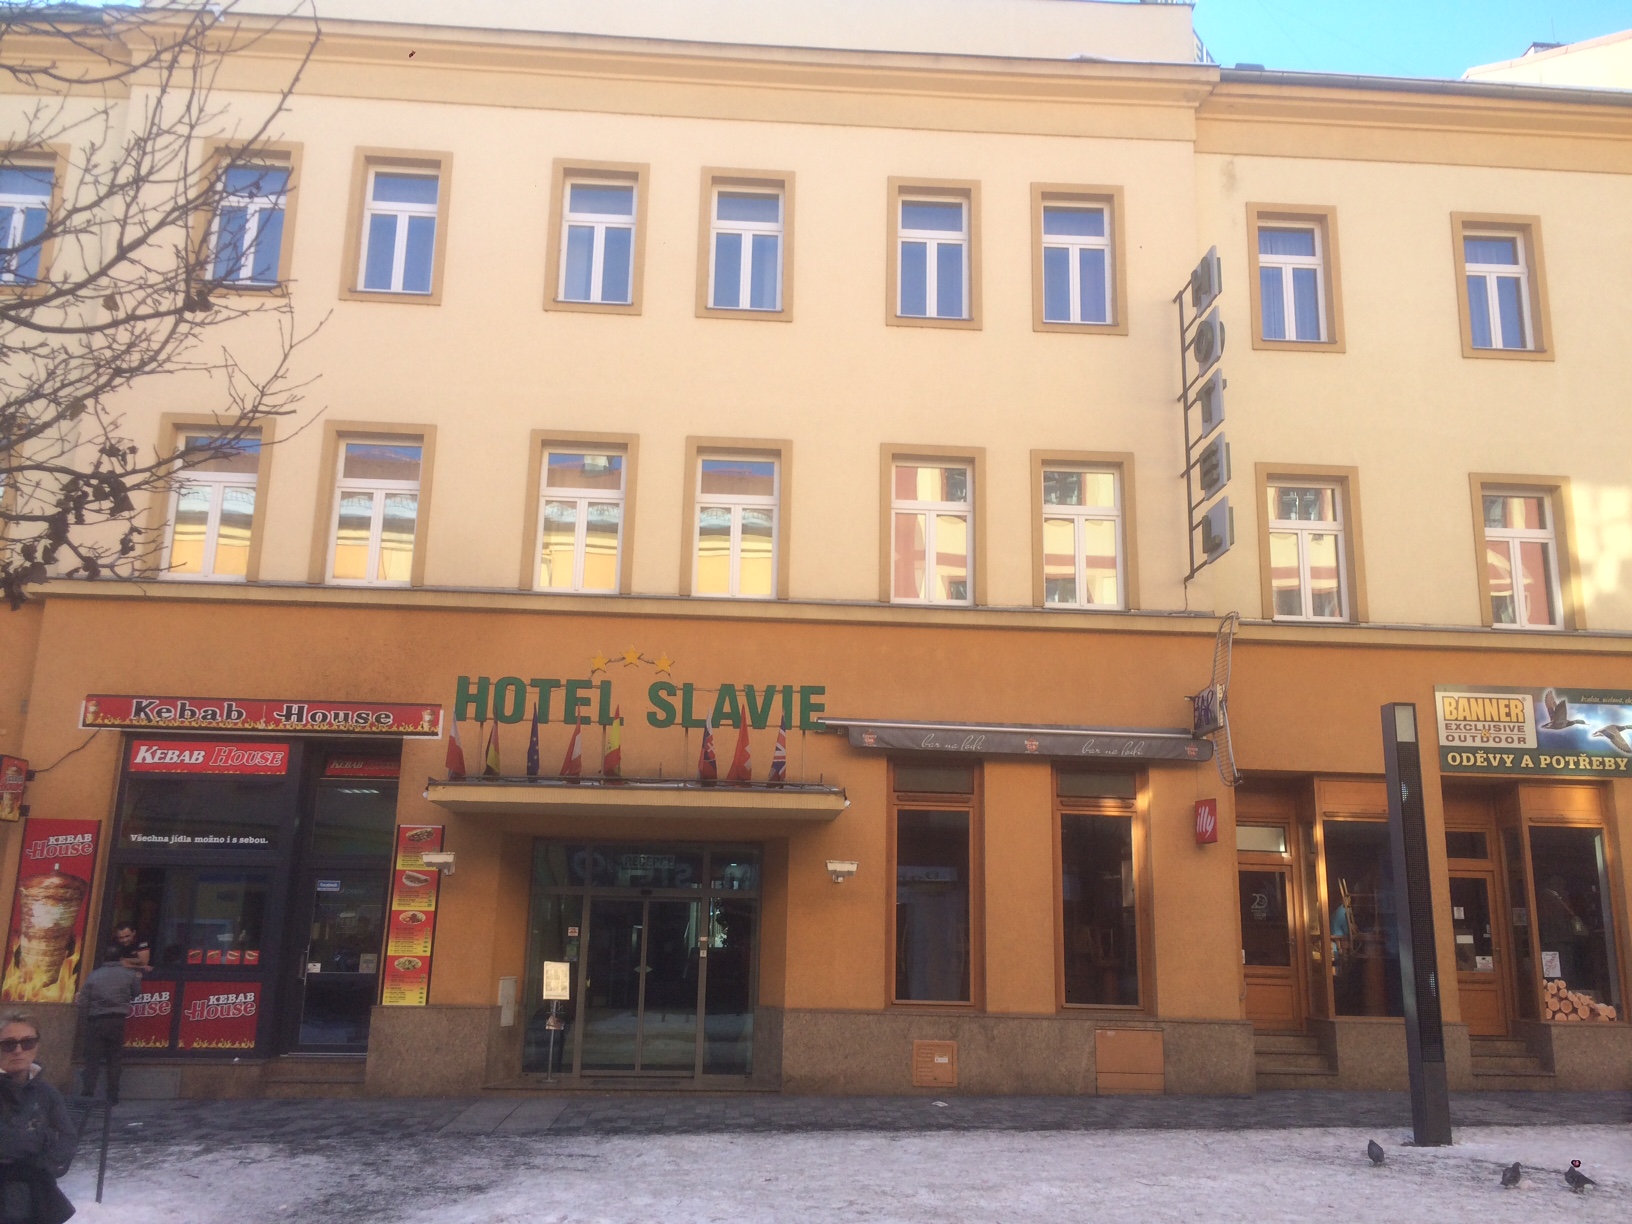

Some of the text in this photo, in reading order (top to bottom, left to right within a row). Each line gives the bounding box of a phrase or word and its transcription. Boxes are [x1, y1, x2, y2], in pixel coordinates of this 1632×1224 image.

[1191, 252, 1226, 556] HOTEL
[455, 675, 827, 731] HOTEL SLAVIE
[1442, 696, 1526, 723] BANNER
[131, 699, 393, 726] Kebab House
[1445, 723, 1526, 733] EXCLUSIVE
[921, 732, 941, 748] bar
[1081, 739, 1101, 754] bar
[1445, 734, 1527, 745] OUTDOOR
[134, 746, 285, 767] KEBAB HOUSE
[1447, 750, 1629, 771] ODĚVY A POTŘEBY
[1196, 806, 1215, 838] illy
[48, 833, 93, 845] KEBAB
[130, 834, 169, 842] Všechna
[169, 834, 192, 844] jídla
[194, 834, 225, 844] možno
[238, 836, 269, 844] sebou.
[25, 841, 93, 859] House
[130, 992, 170, 1004] EBAB
[209, 993, 255, 1005] KEBAB
[185, 1000, 256, 1020] House
